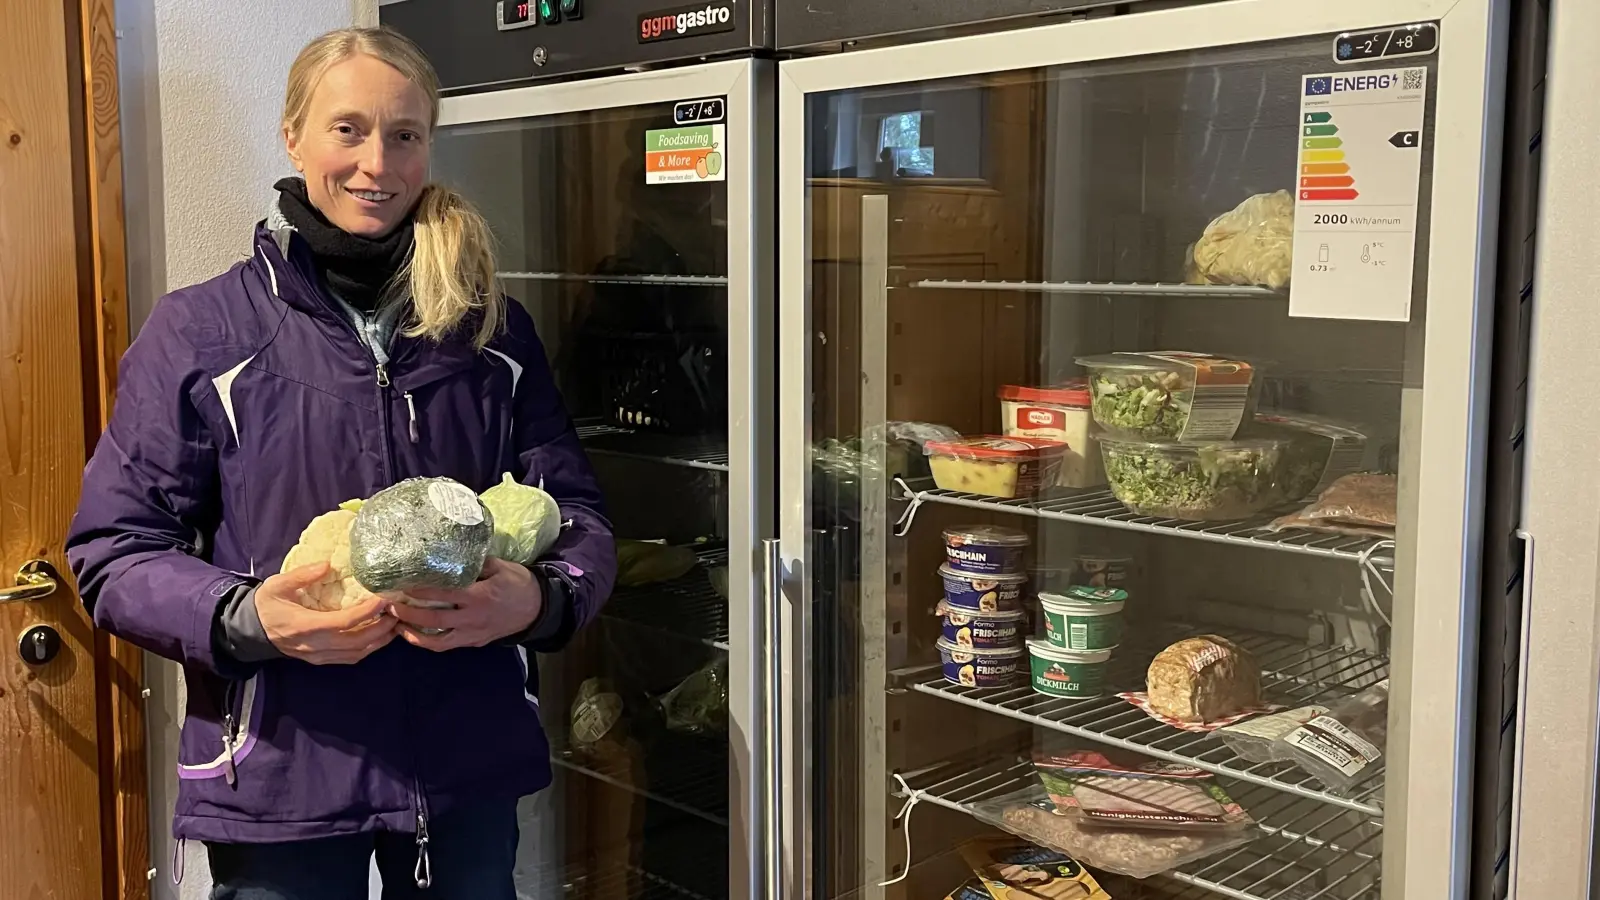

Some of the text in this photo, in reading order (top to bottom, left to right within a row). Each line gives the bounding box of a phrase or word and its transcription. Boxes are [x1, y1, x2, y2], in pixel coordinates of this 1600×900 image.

[1334, 75, 1390, 92] ENERG
[1306, 114, 1312, 122] A
[1306, 127, 1311, 135] B
[658, 132, 709, 147] Foodsaving
[1403, 133, 1412, 145] C
[658, 155, 691, 167] & More
[1313, 213, 1401, 225] 2000 kWh/annum
[1036, 675, 1080, 691] DICKMILCH
